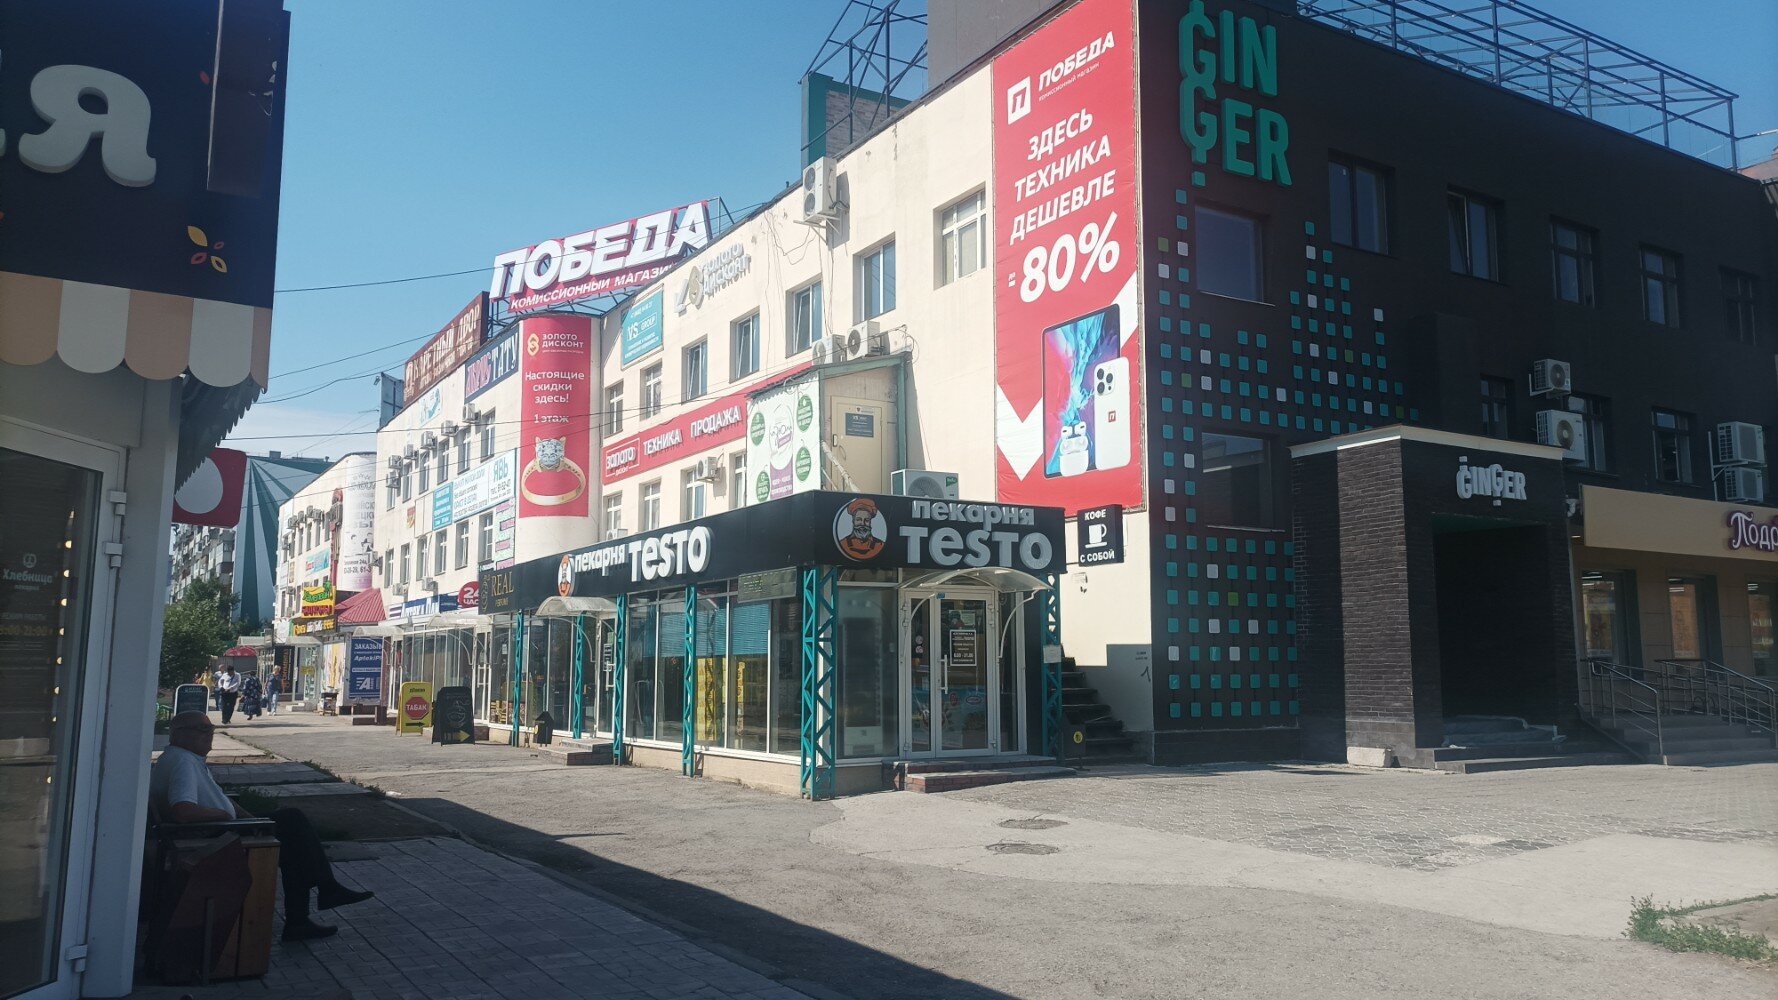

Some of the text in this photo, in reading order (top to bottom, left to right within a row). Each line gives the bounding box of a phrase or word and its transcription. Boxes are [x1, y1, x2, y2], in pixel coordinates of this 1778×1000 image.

[1038, 30, 1115, 92] ПОБЕДА
[1027, 107, 1094, 161] ЗДЕСЬ
[1014, 134, 1111, 202] ТЕХНИКА
[1009, 169, 1117, 246] ДЕШЕВЛЕ
[489, 201, 712, 300] ПОБЕДА
[542, 333, 578, 341] ЗОЛОТО
[542, 340, 584, 348] ДИСКОНТ
[525, 371, 585, 381] Настоящие
[533, 383, 573, 392] скидки
[535, 393, 570, 404] здесь!
[534, 414, 570, 423] 1 этаж
[606, 447, 637, 469] ЗОЛОТО
[643, 428, 683, 457] ТЕХНИКА
[690, 405, 742, 439] ПРОДАЖА
[1456, 455, 1527, 506] GINGER
[912, 500, 1035, 532] пекарня
[1084, 508, 1106, 521] КОФЕ
[574, 543, 626, 577] пекарня
[1079, 549, 1115, 564] С СОБОЙ
[491, 571, 515, 597] REAL
[406, 703, 427, 711] ТАБАК
